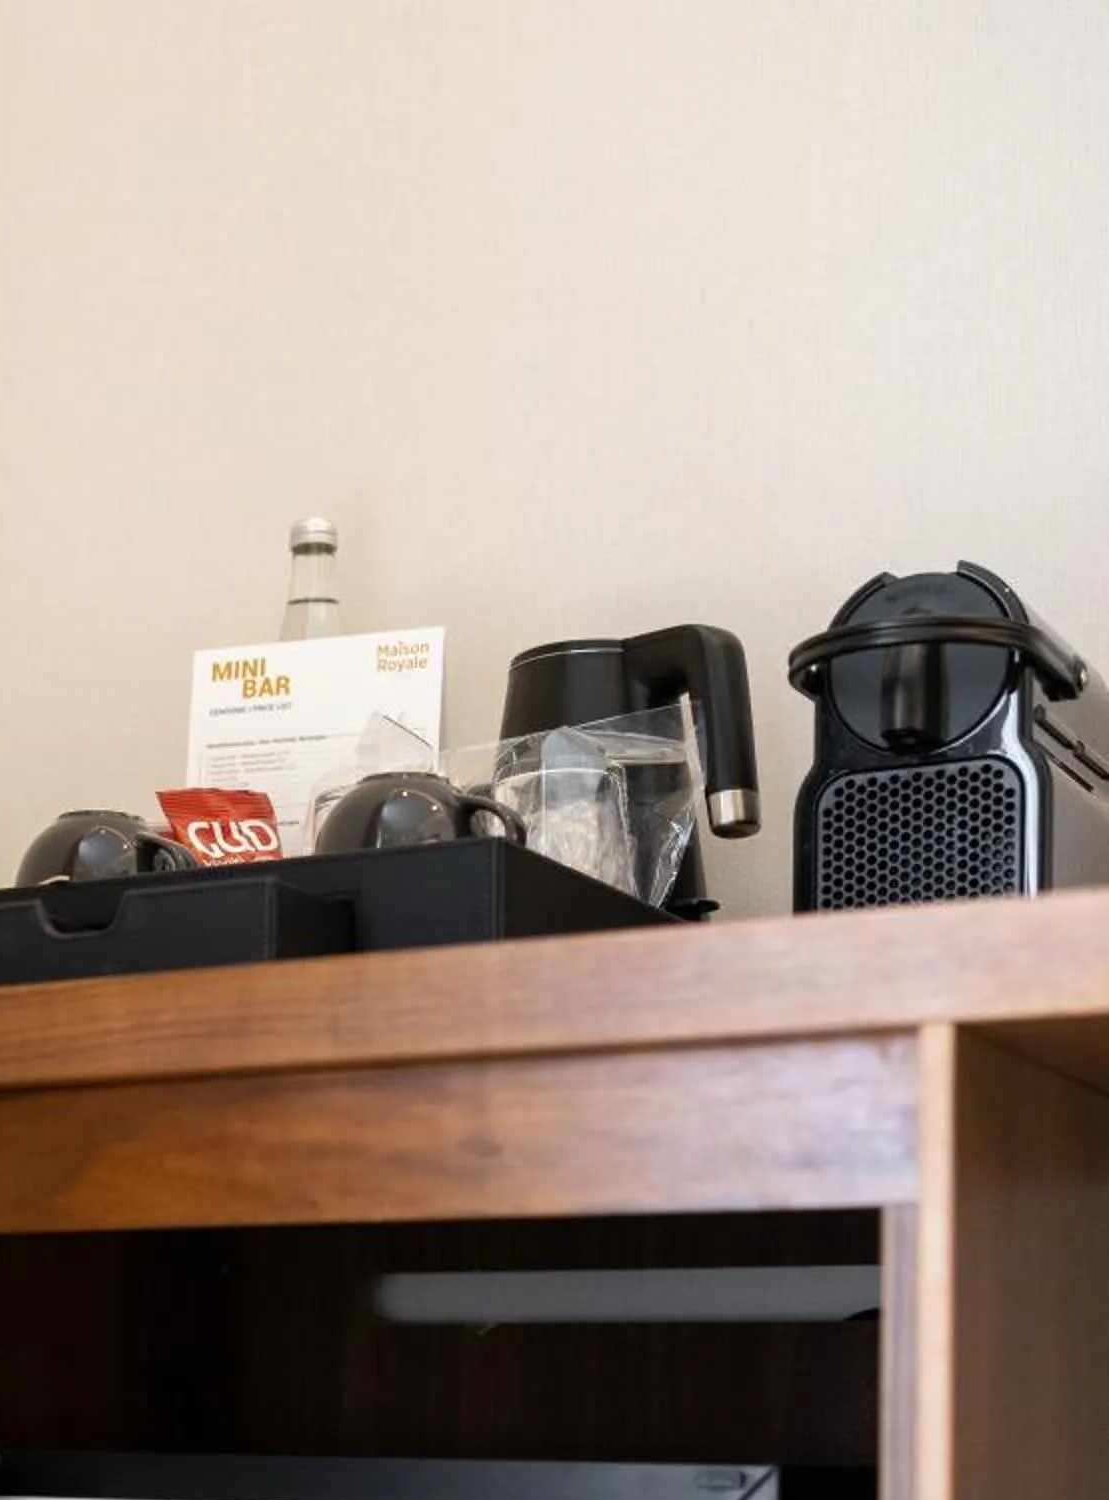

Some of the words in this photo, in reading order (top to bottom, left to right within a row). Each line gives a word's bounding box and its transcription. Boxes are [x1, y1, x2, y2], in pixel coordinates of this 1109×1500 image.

[376, 640, 430, 657] Maison
[211, 657, 266, 682] MINI
[376, 655, 428, 673] Royale
[242, 675, 291, 699] BAR
